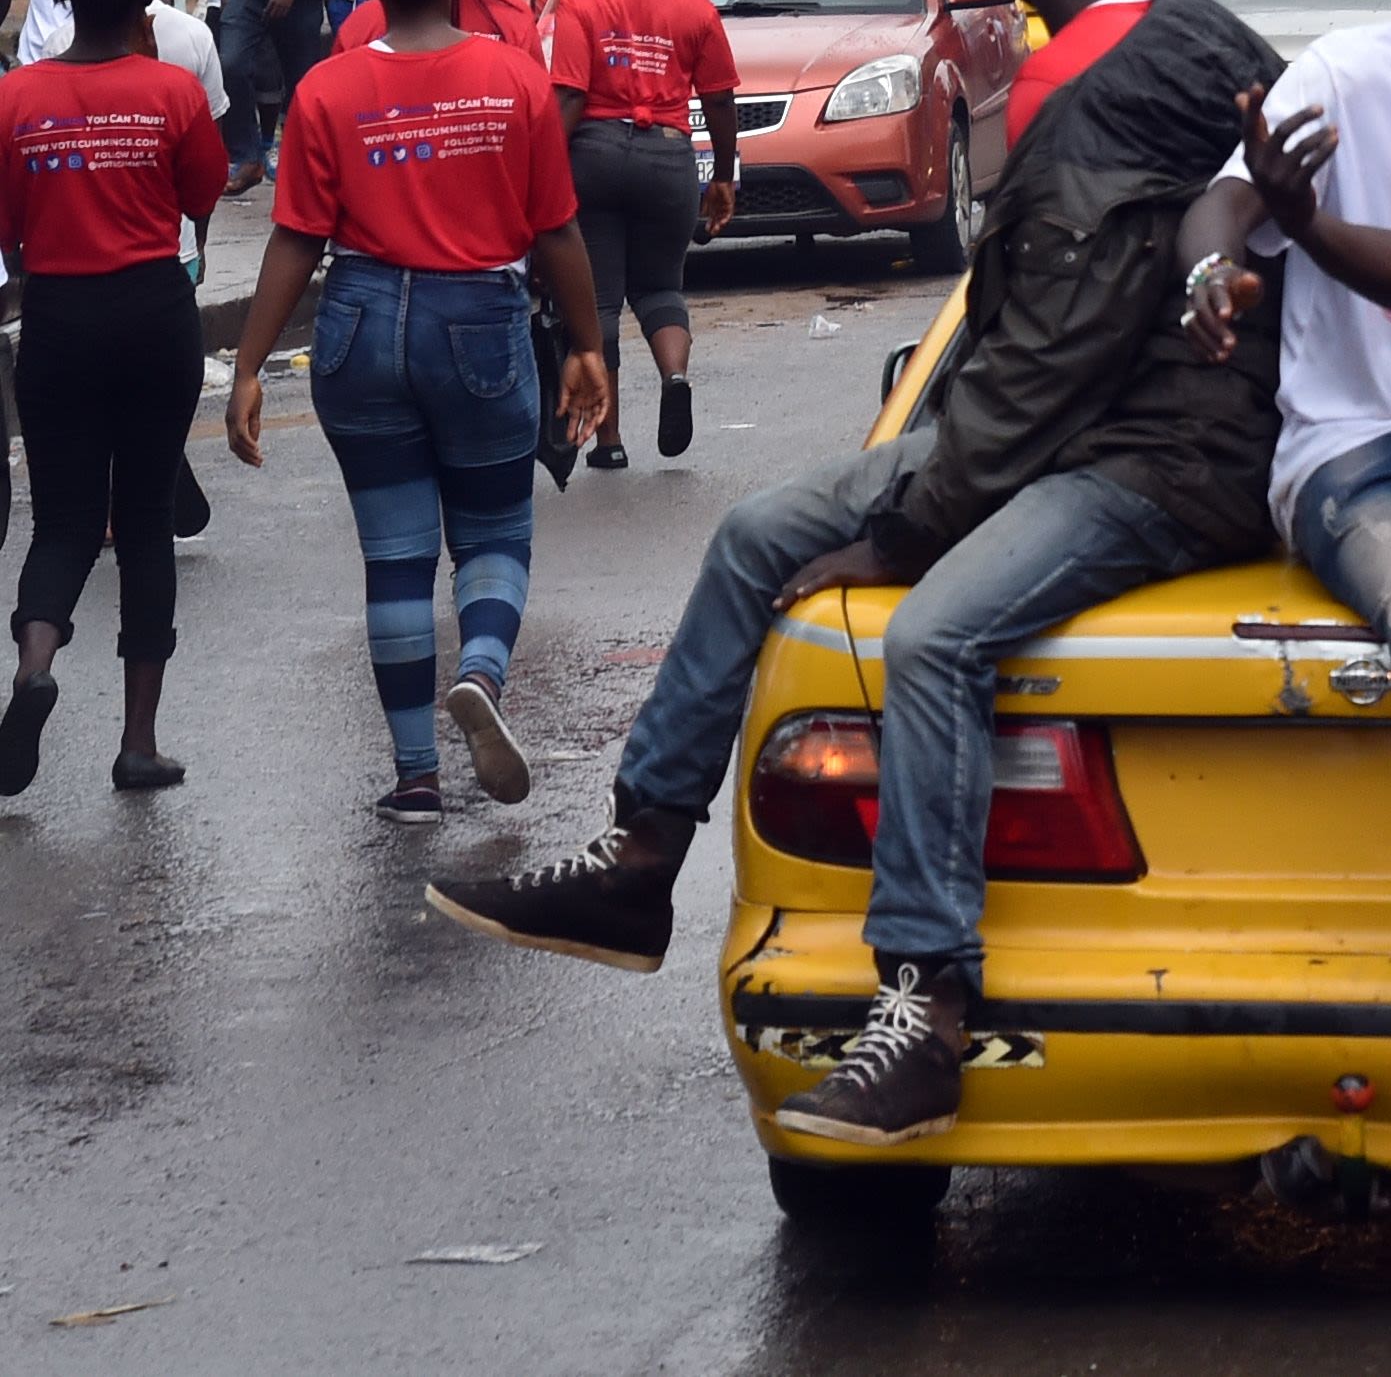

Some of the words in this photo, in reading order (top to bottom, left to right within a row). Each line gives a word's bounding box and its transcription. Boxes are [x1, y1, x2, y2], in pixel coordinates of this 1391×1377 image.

[433, 102, 456, 112] YOU
[457, 98, 480, 109] CAN
[482, 96, 515, 108] TRUST
[86, 116, 107, 125] YOU
[110, 114, 131, 123] CAN
[133, 114, 165, 125] TRUST
[363, 122, 507, 145] WWW.VOTECUMMINGS.OM
[444, 136, 483, 147] FOLLOW
[95, 151, 129, 159] FOLLOW
